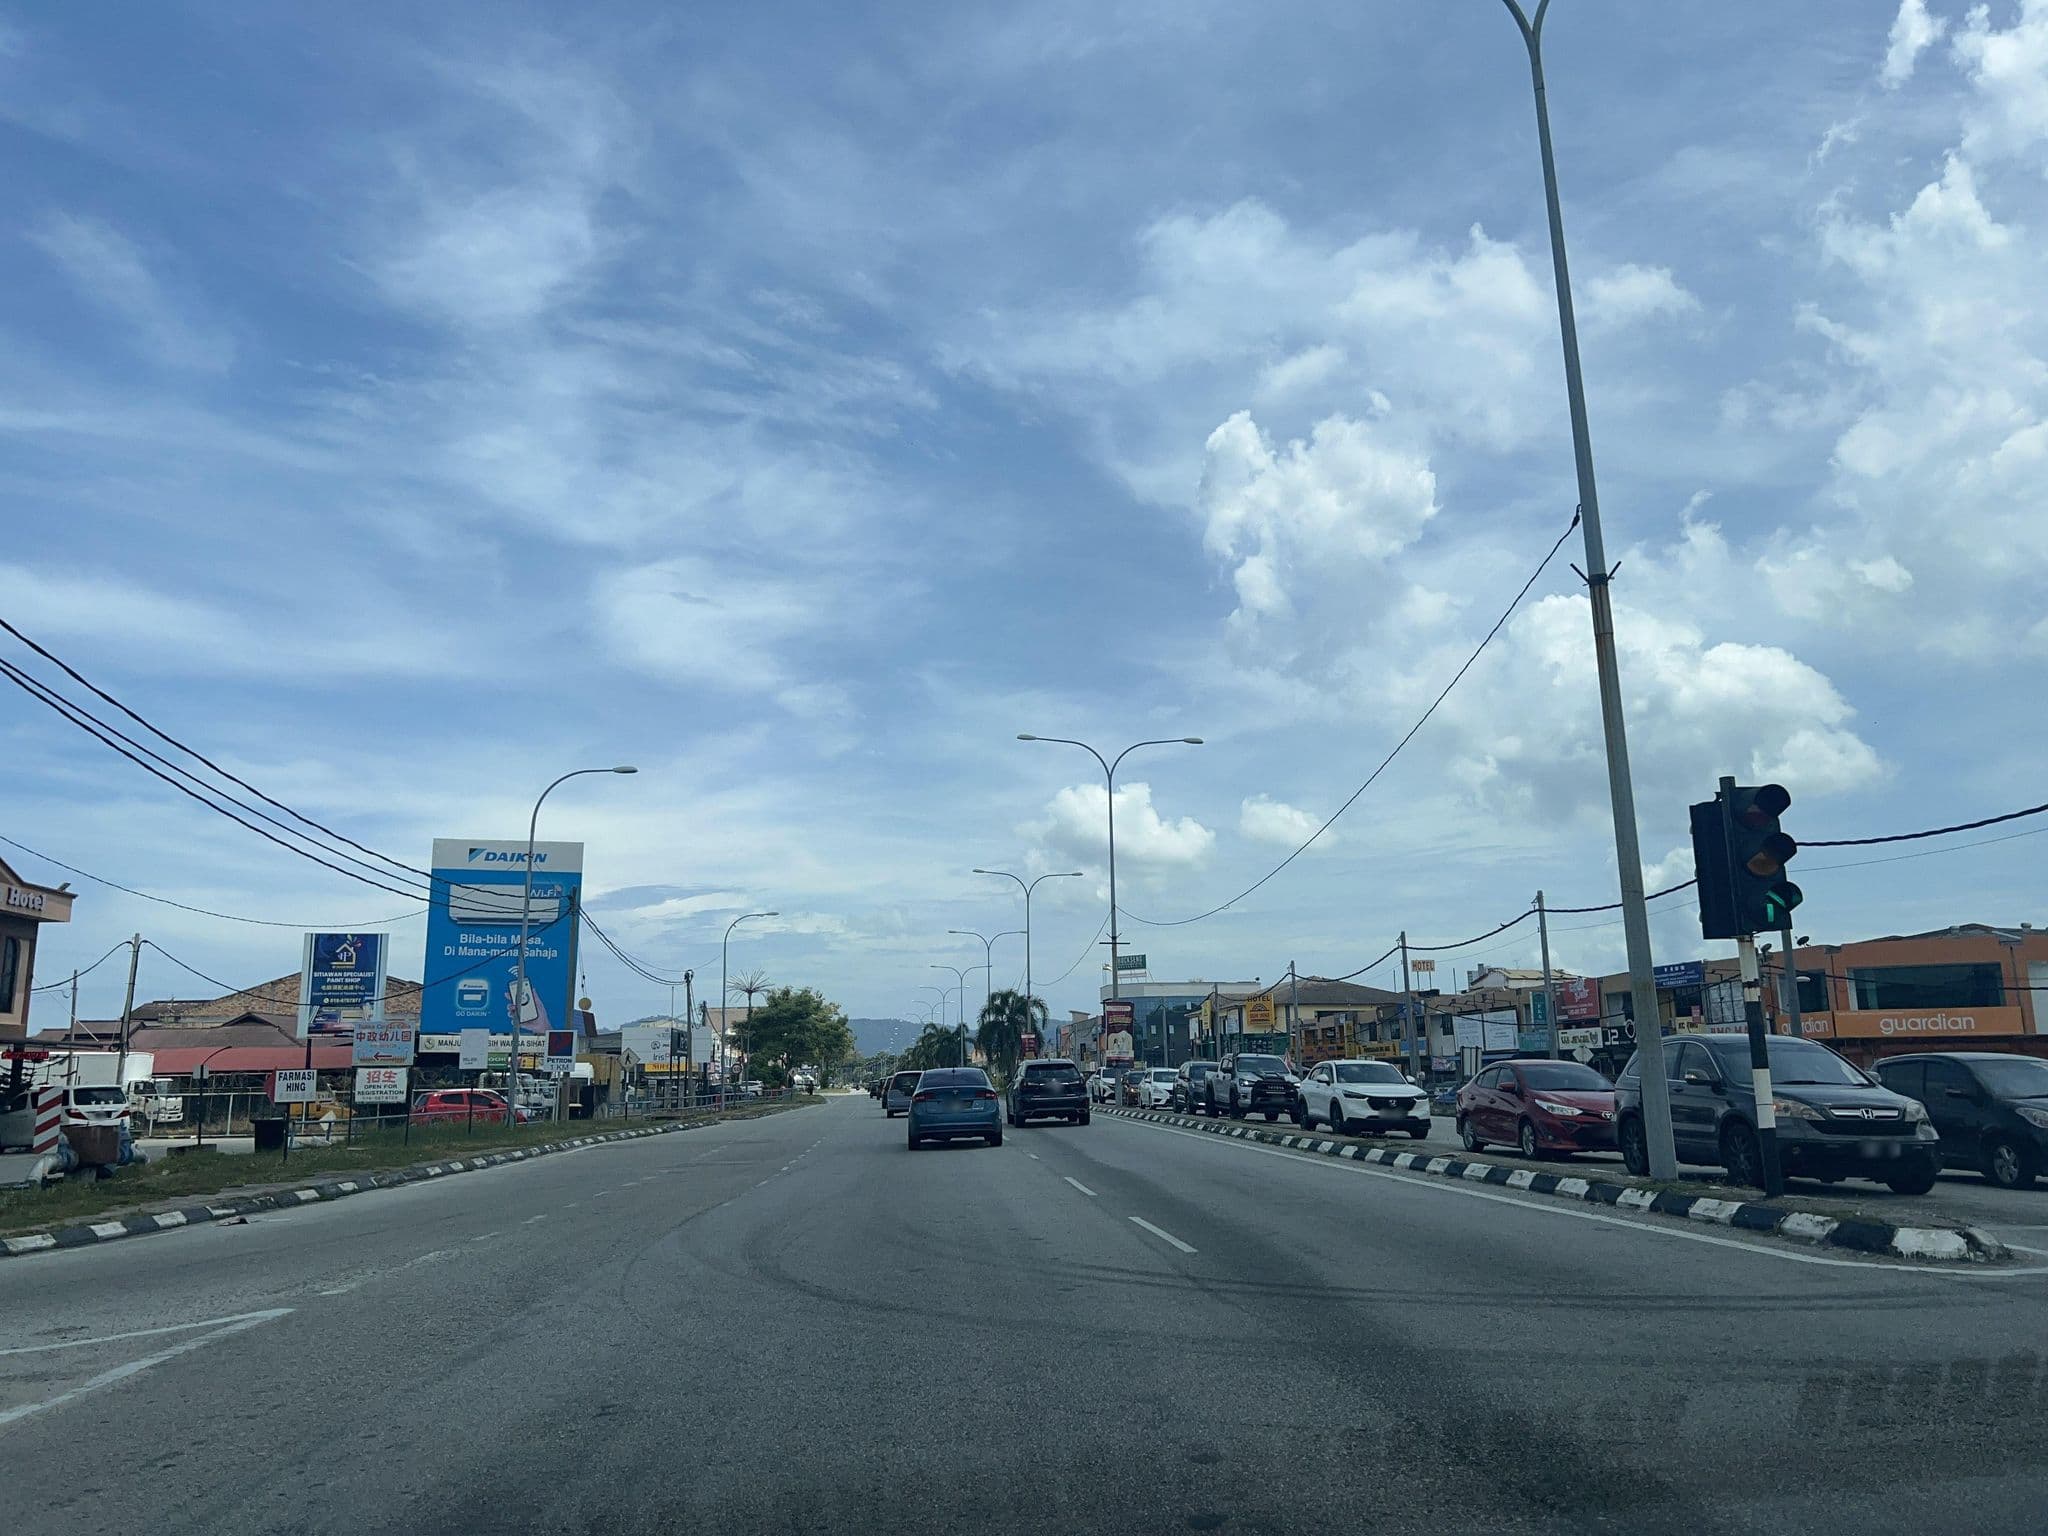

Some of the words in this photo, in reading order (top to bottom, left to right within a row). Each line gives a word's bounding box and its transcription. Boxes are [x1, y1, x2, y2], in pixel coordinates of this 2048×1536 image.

[484, 851, 548, 863] DAIKN
[8, 887, 47, 911] Hotel
[460, 933, 507, 944] Bila-bila
[511, 934, 545, 946] Msa,
[444, 946, 455, 956] Di
[458, 946, 519, 957] Mana-mana
[524, 947, 558, 959] Sahaja
[1412, 960, 1434, 971] HOTEL
[1880, 1013, 1976, 1035] guardian
[437, 1039, 462, 1047] MANJU
[278, 1071, 315, 1081] FARMASI
[367, 1070, 398, 1083] 招生
[286, 1083, 306, 1092] HING
